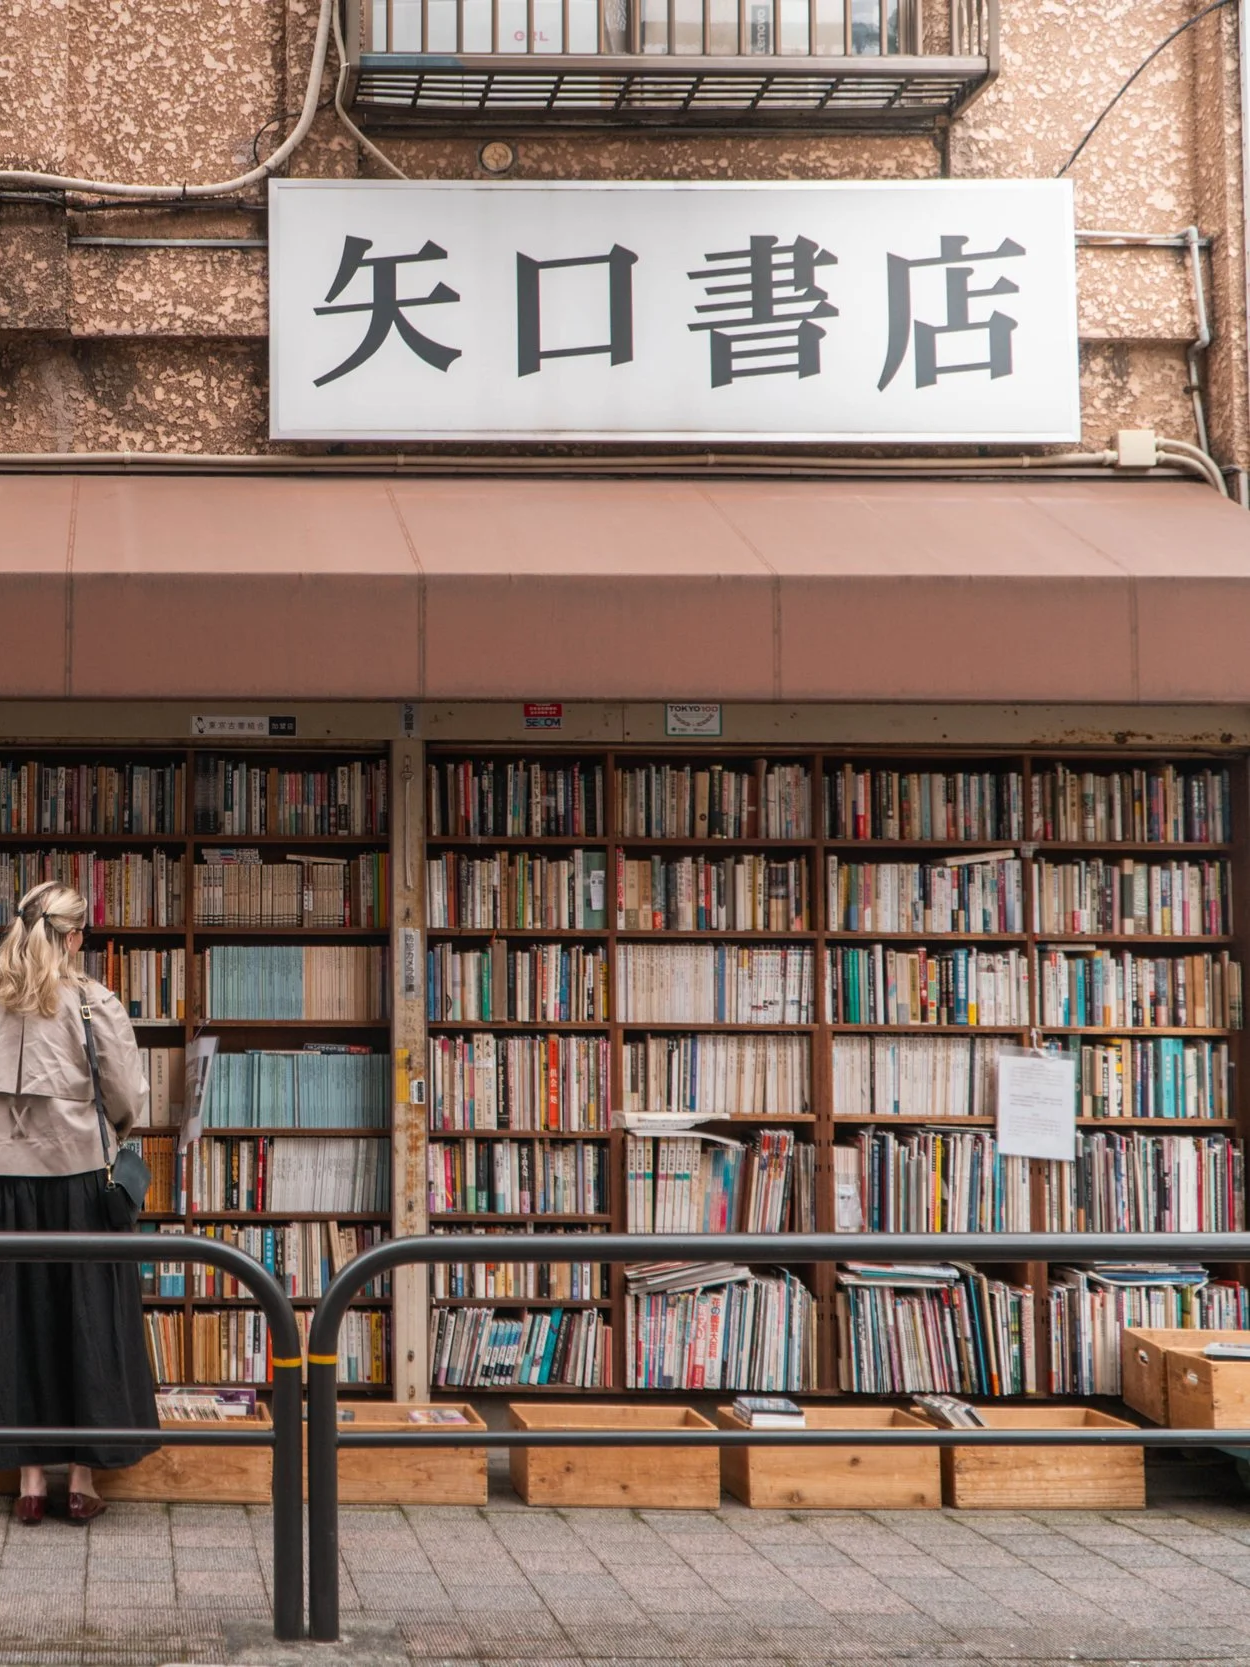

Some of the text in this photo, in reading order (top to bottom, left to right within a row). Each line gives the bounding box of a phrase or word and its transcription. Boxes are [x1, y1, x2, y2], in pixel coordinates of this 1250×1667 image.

[312, 234, 1027, 393] 矢口書店
[525, 718, 561, 727] SECOM
